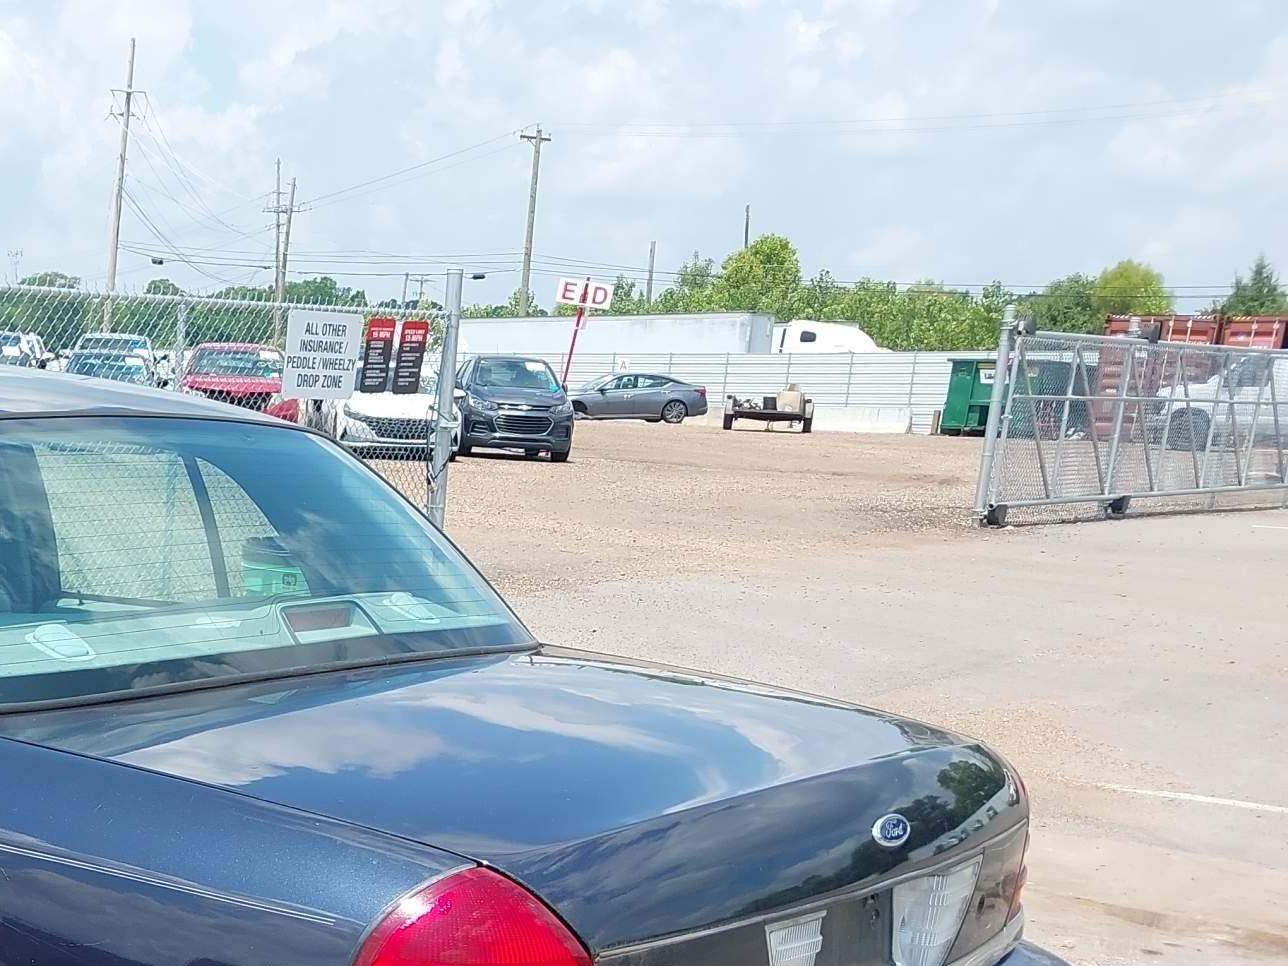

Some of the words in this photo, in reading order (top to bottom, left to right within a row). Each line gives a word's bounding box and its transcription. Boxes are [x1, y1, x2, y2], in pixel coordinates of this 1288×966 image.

[305, 322, 319, 336] ALL
[322, 323, 347, 337] OTHER
[286, 356, 317, 369] PEDDLE
[296, 373, 320, 388] DROP
[321, 375, 343, 389] ZONE
